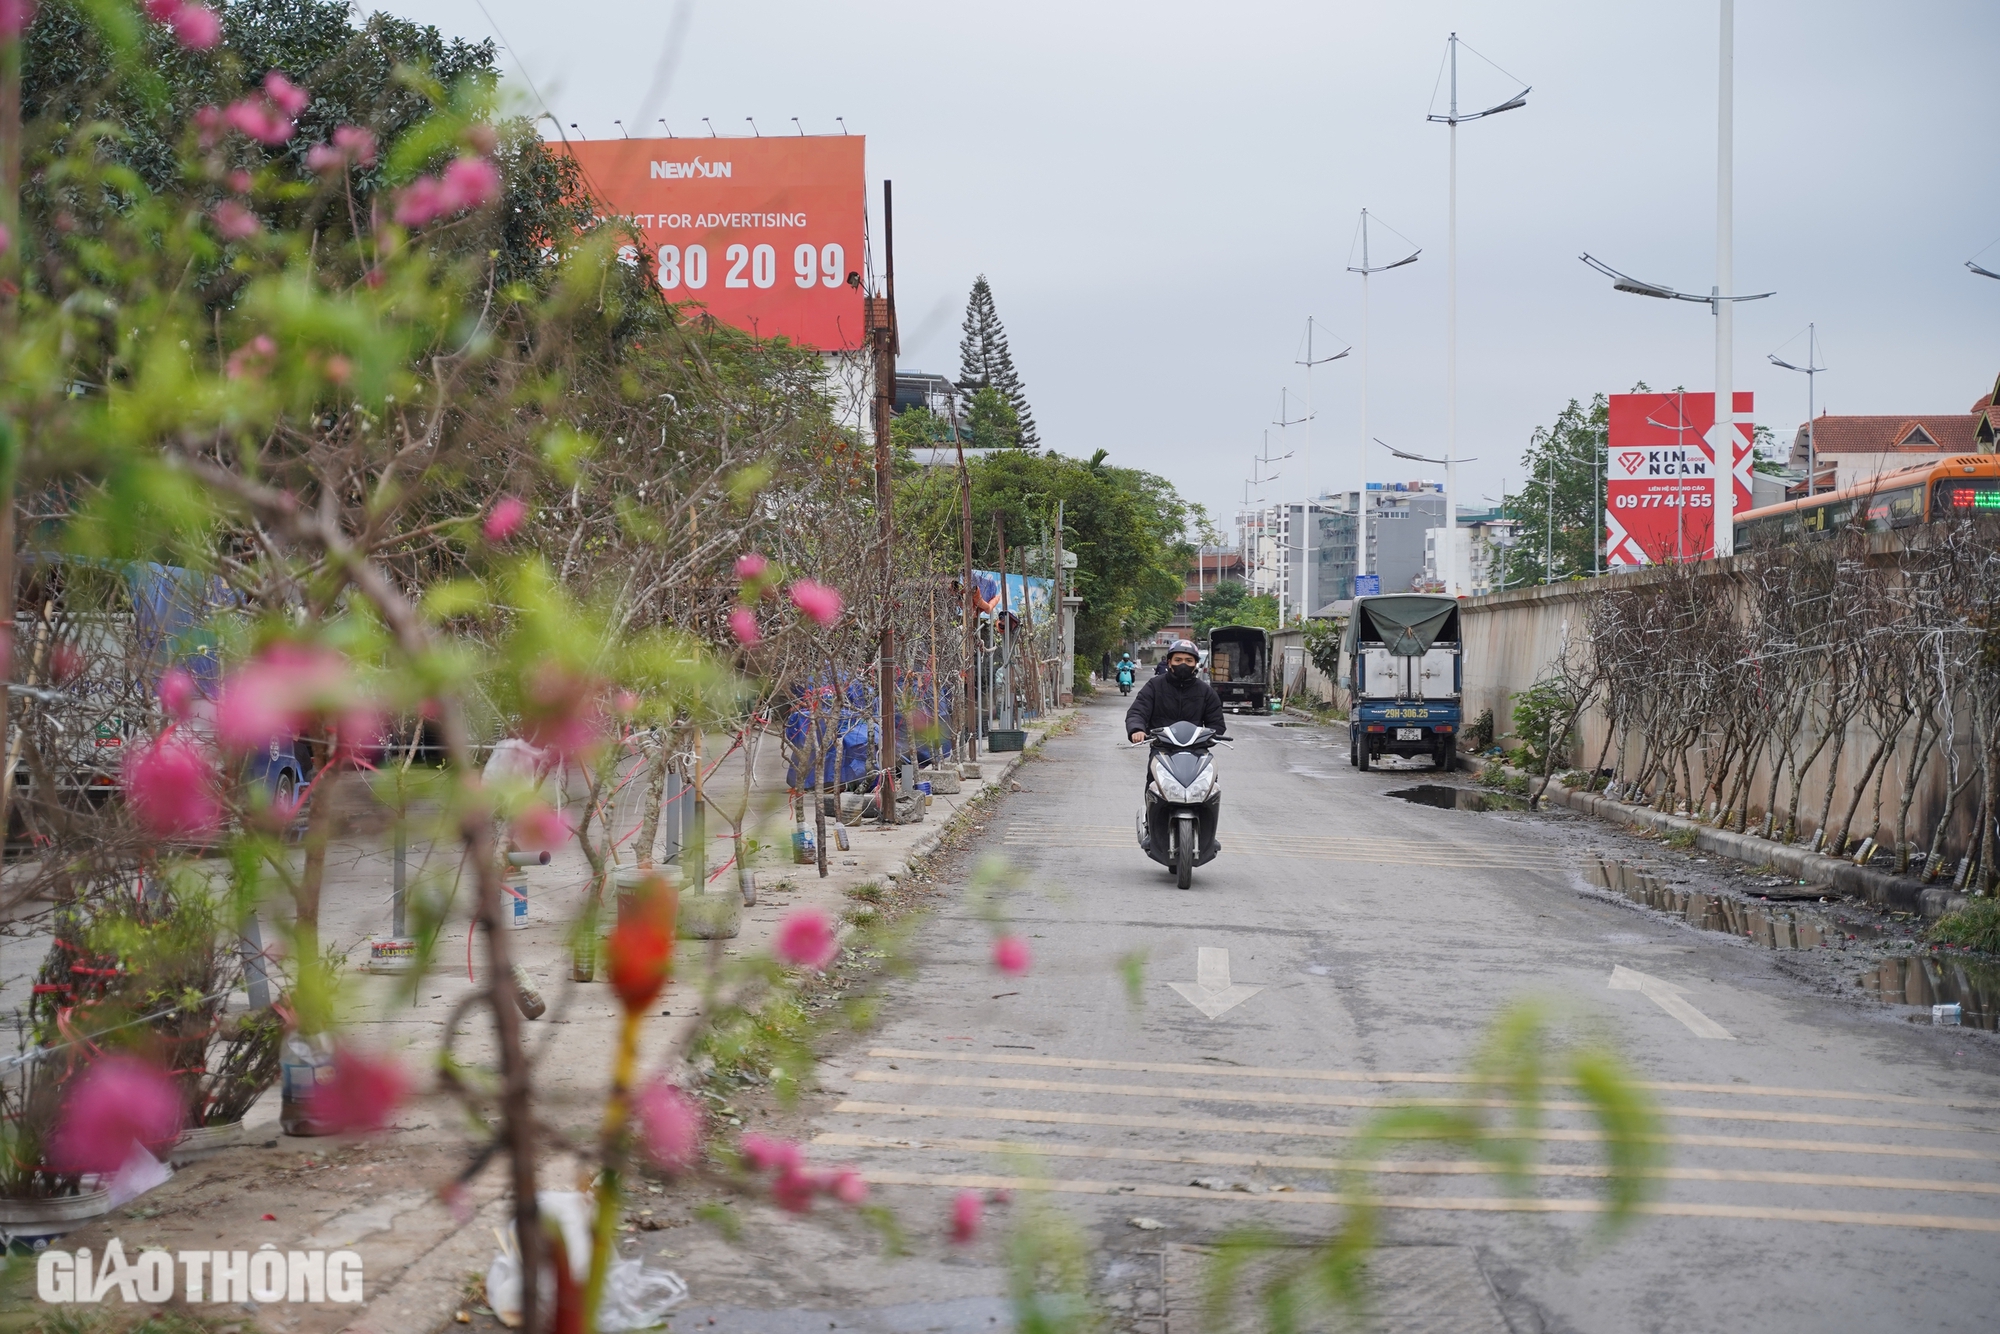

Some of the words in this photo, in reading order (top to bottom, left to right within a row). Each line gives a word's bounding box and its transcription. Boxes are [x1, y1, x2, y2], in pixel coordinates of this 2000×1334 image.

[650, 156, 732, 179] NEWSUN
[658, 213, 690, 229] FOR
[694, 212, 807, 228] ADVERTISING
[657, 244, 708, 290] 80
[725, 243, 776, 289] 20
[793, 242, 845, 289] 99
[1649, 451, 1685, 463] KIM
[1649, 463, 1706, 475] NGAN
[1616, 494, 1638, 508] 09
[1640, 494, 1663, 508] 77
[1663, 493, 1686, 508] 44
[1690, 493, 1712, 507] 55
